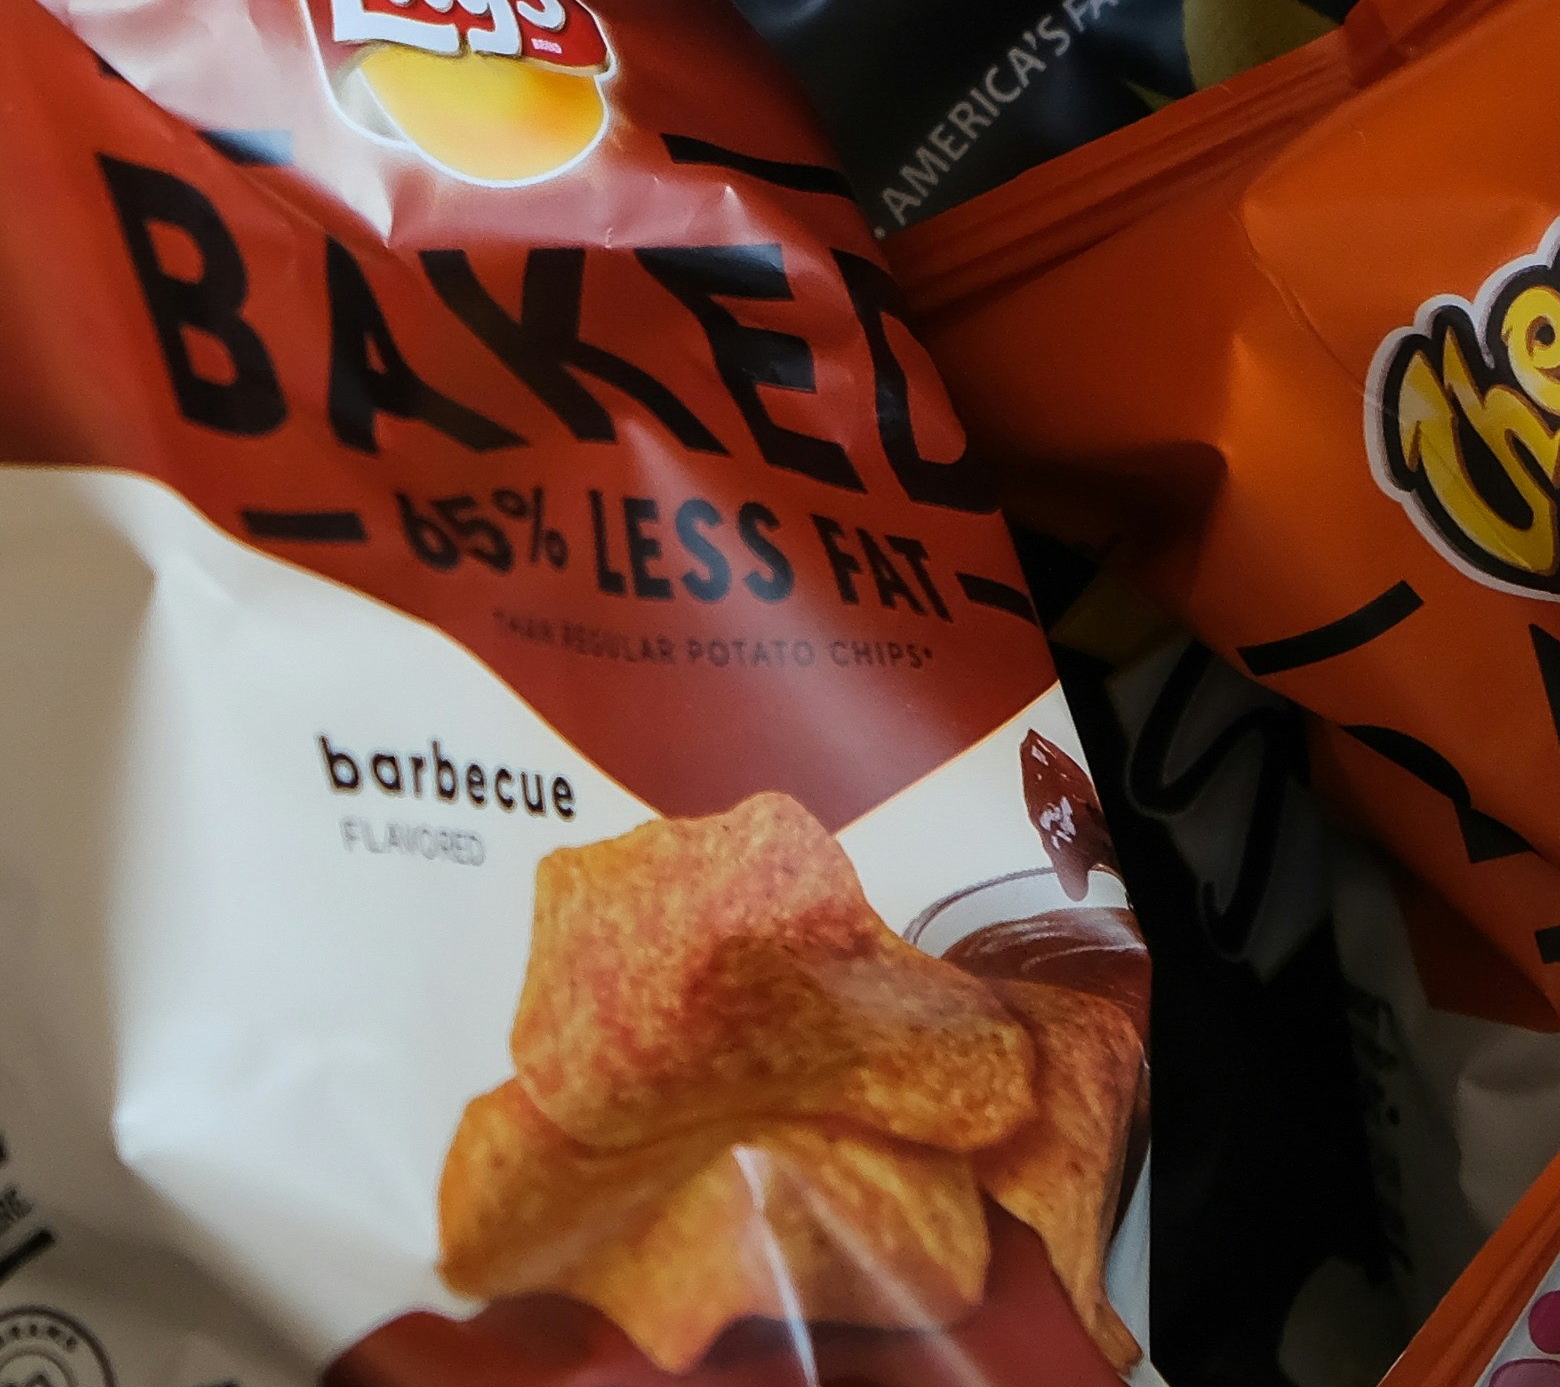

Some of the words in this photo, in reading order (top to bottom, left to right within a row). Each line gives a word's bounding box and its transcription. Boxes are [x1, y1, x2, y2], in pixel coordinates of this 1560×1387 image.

[880, 15, 1071, 225] AMERICA'S
[96, 152, 1003, 517] BAKED
[396, 491, 571, 574] 65%
[589, 488, 795, 605] LESS
[822, 515, 954, 624] FAT
[685, 640, 817, 671] POTATO
[318, 734, 579, 822] barbecue
[341, 820, 488, 868] FLAVORED
